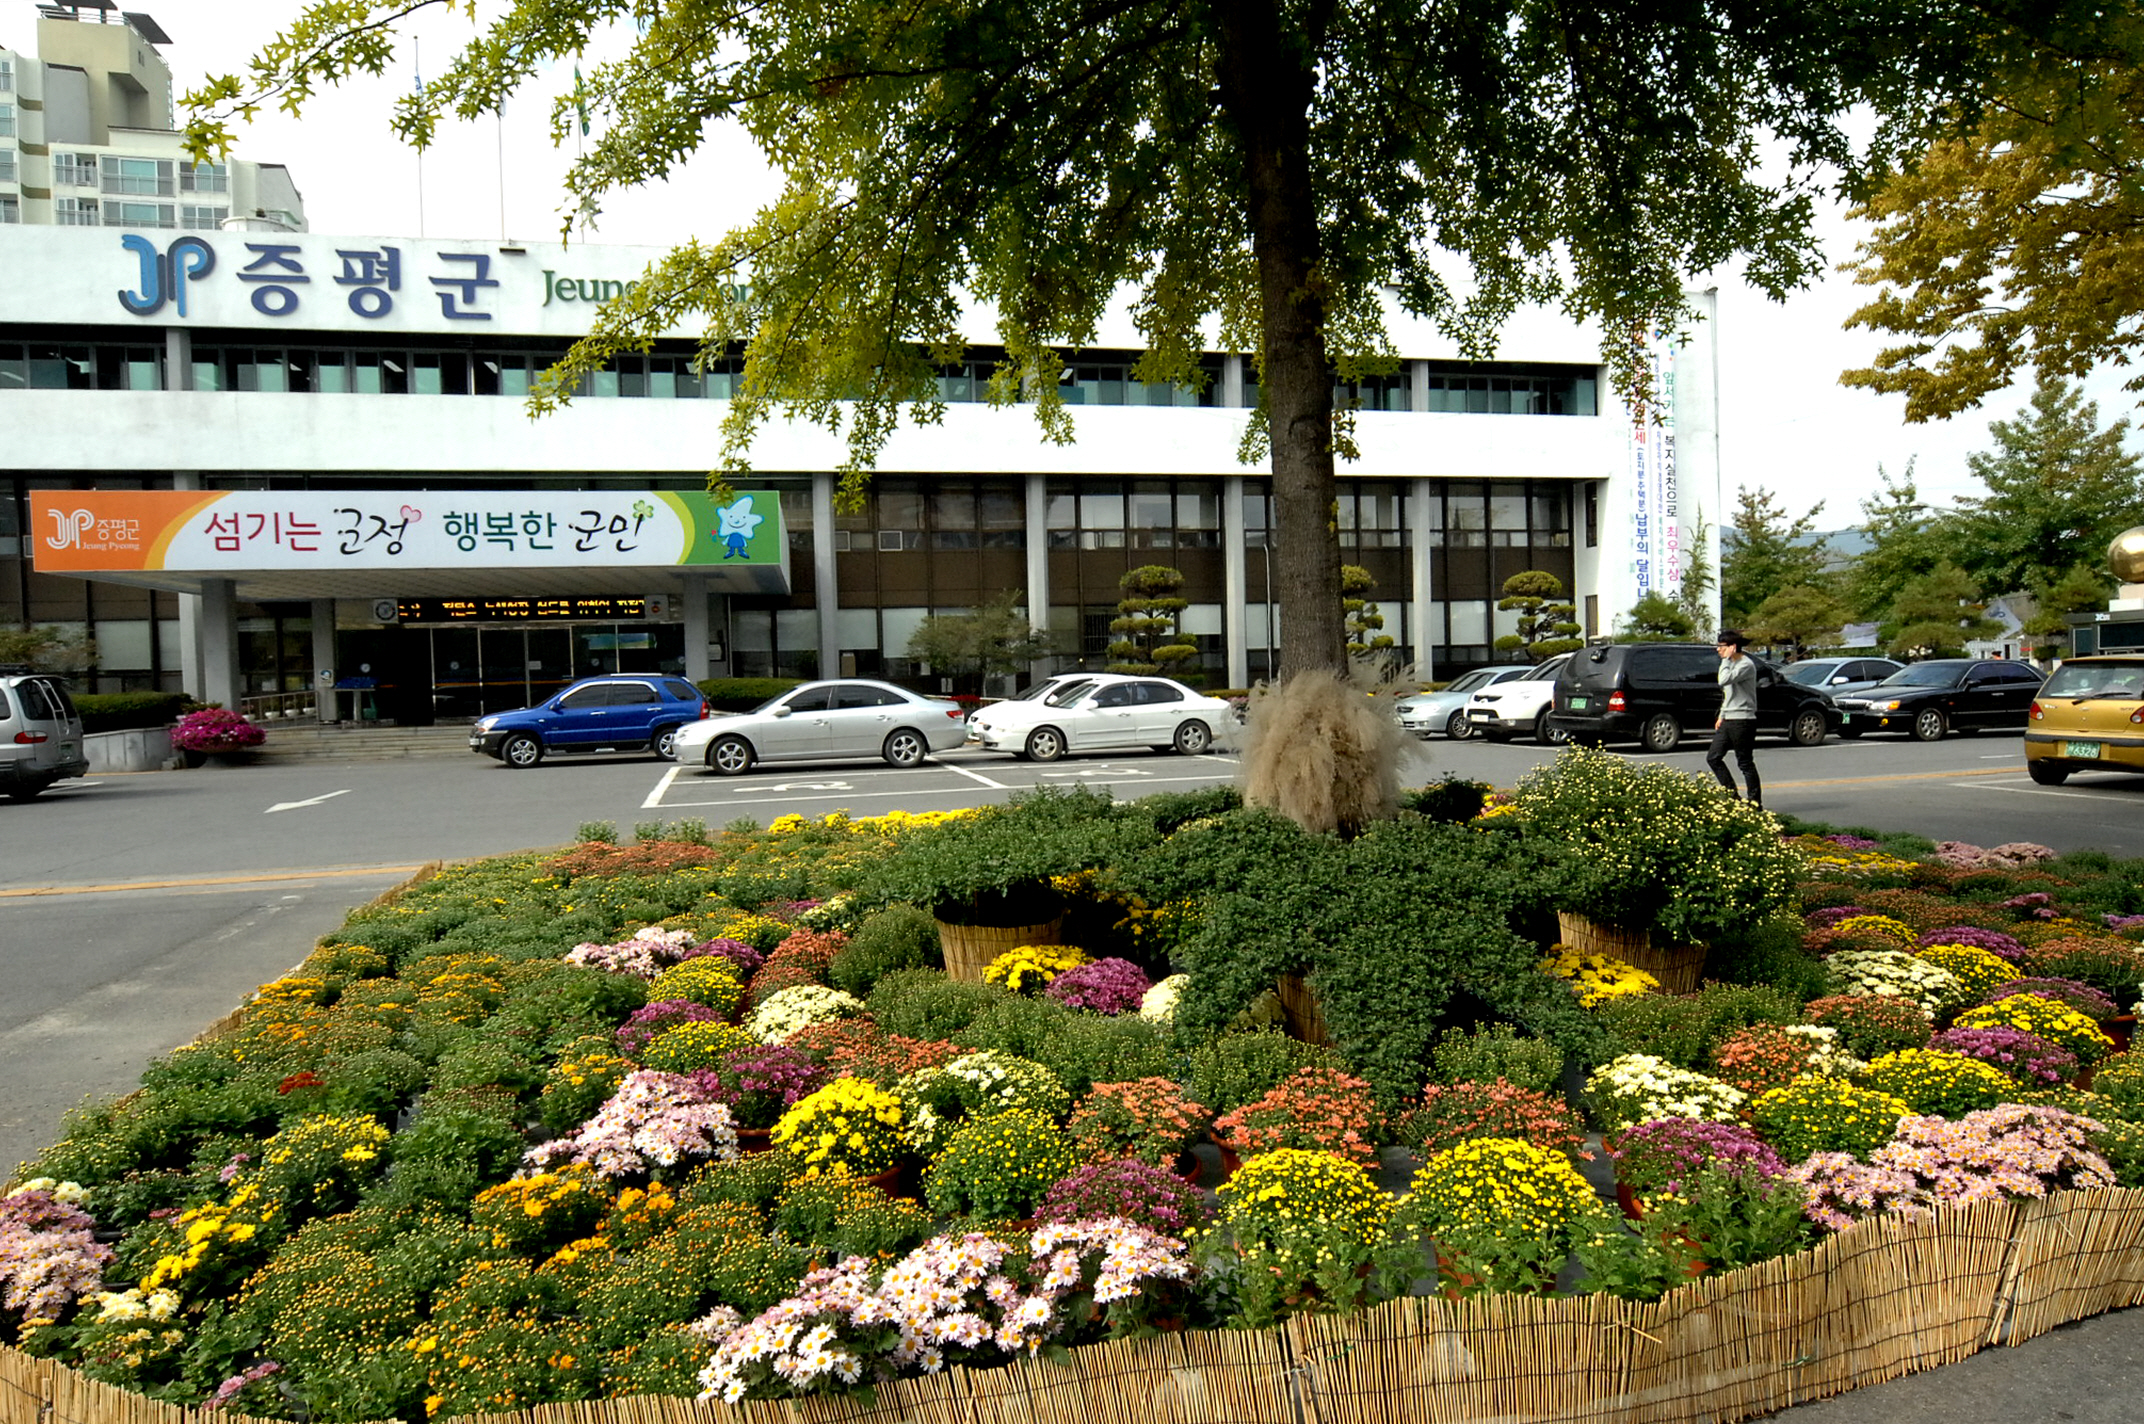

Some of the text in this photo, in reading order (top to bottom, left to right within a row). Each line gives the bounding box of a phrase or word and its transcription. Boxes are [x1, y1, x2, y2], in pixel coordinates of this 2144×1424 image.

[236, 242, 500, 320] 증평군
[1662, 371, 1680, 602] 앞서가는 복지실천으로 최우수상 수
[82, 542, 140, 551] Jeung Pyeong
[97, 518, 140, 541] 증평군
[203, 508, 645, 555] 섬기는 군정 행복한 군민
[1635, 513, 1649, 555] 납부의
[1636, 559, 1650, 598] 달입니
